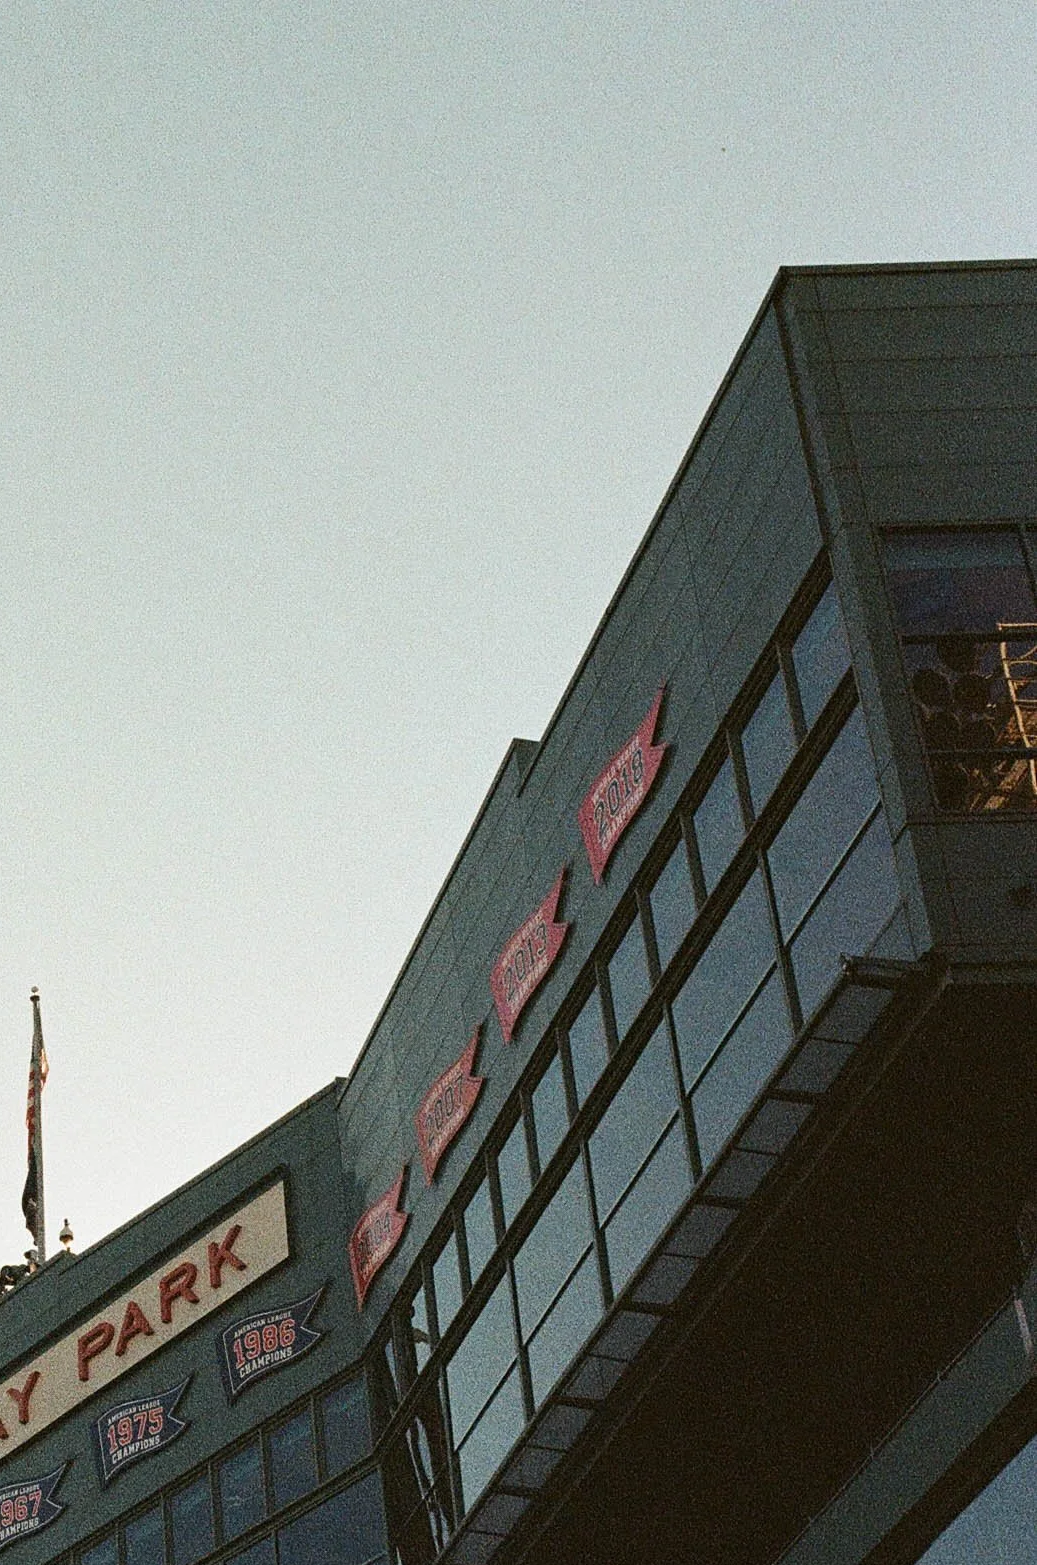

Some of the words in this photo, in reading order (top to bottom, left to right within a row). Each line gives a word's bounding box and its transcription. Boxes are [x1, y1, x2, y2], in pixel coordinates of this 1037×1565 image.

[594, 747, 644, 844] 2018
[504, 921, 548, 1002] 2013
[76, 1223, 249, 1382] PARK
[234, 1318, 266, 1338] AMERICAN
[267, 1311, 292, 1323] LEAGUE
[233, 1318, 296, 1369] 1986
[239, 1346, 293, 1378] CHAMPIONS
[107, 1407, 163, 1454] 1975
[111, 1435, 160, 1464] CHAMPIONS
